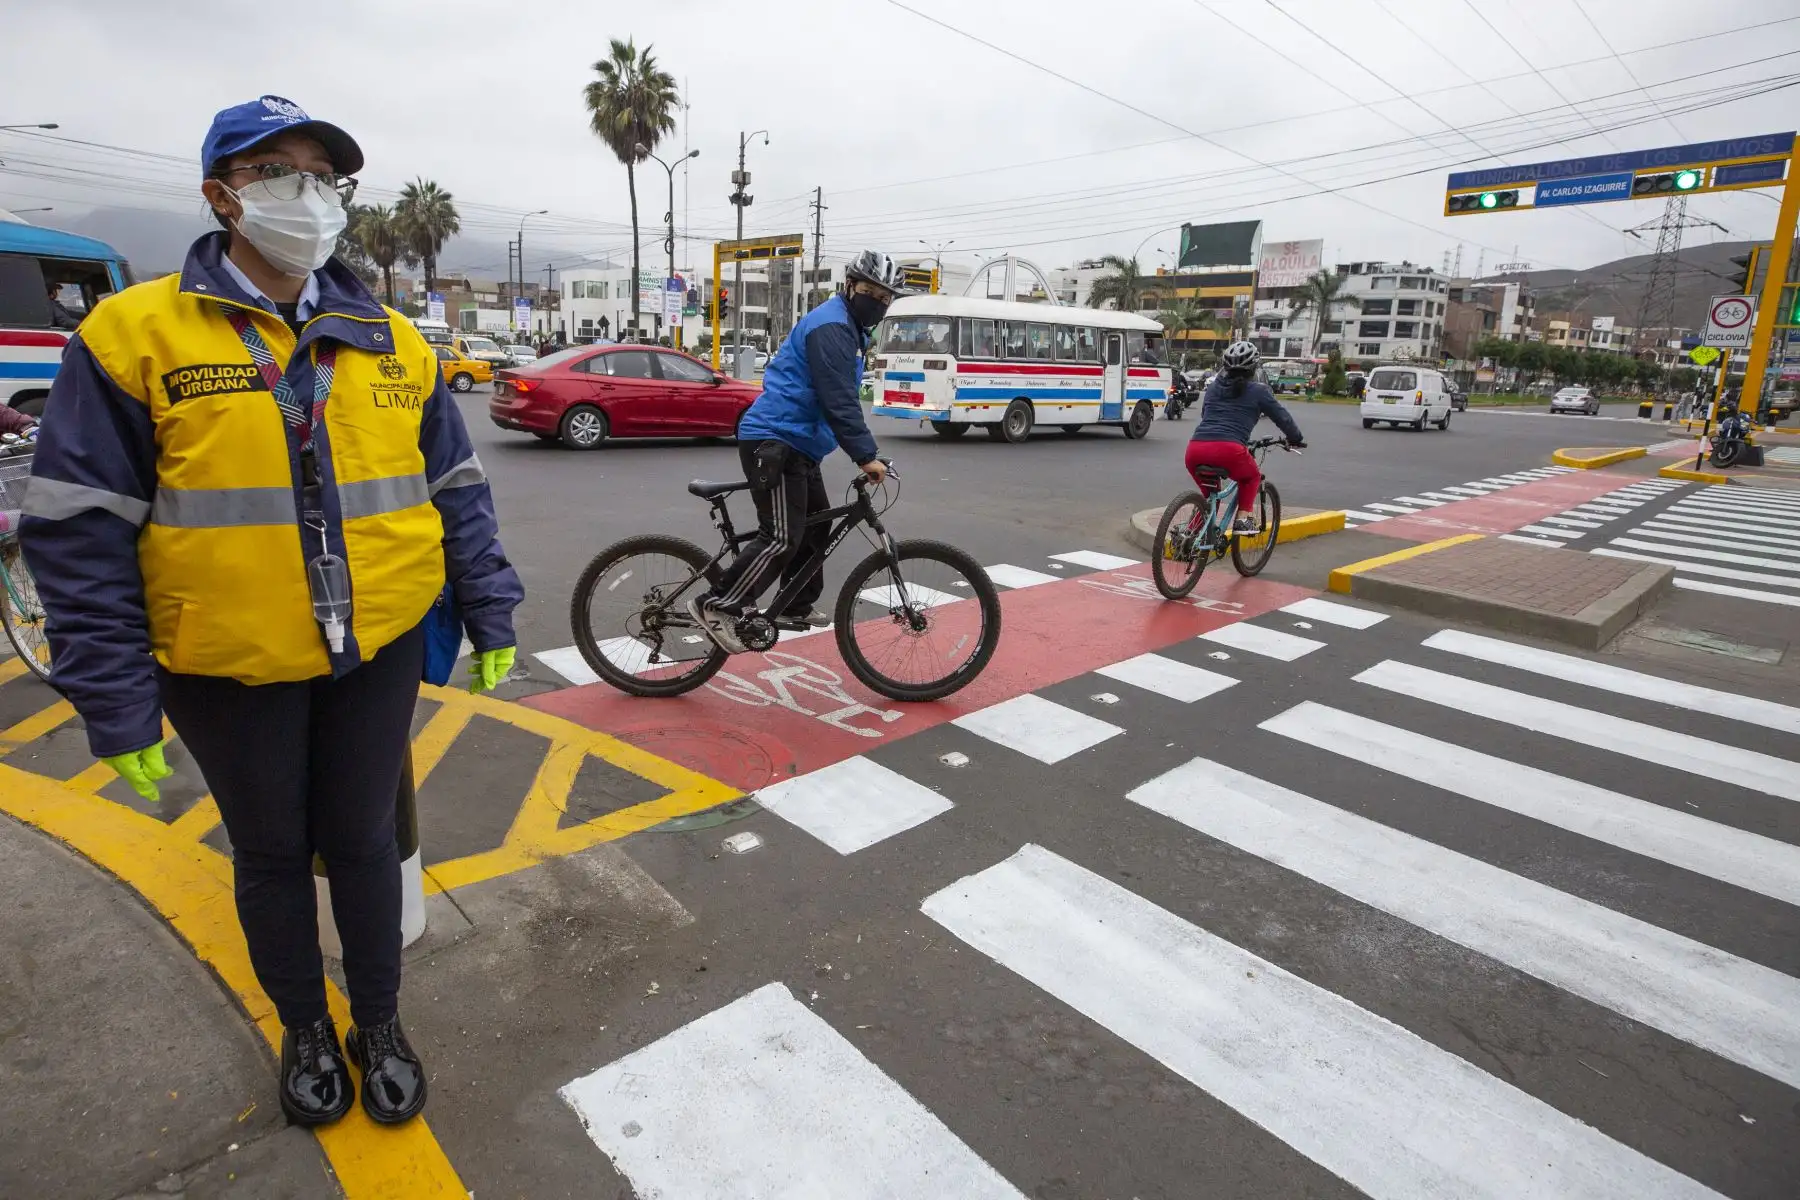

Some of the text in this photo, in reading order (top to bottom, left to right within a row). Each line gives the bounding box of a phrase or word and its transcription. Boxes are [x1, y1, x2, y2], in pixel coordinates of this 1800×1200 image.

[1464, 138, 1776, 186] MUNICIPALIDAD DE LOS OLIVOS
[1552, 187, 1583, 196] CARLOS
[1584, 181, 1627, 194] IZAGUIRRE
[1283, 241, 1300, 255] SE
[1262, 254, 1319, 272] ALQUILA
[1707, 333, 1746, 341] CICLOVIA
[168, 367, 258, 388] MOVILIDAD
[180, 378, 252, 397] URBANA
[372, 391, 422, 411] LIMA
[824, 524, 849, 556] GOLIAT
